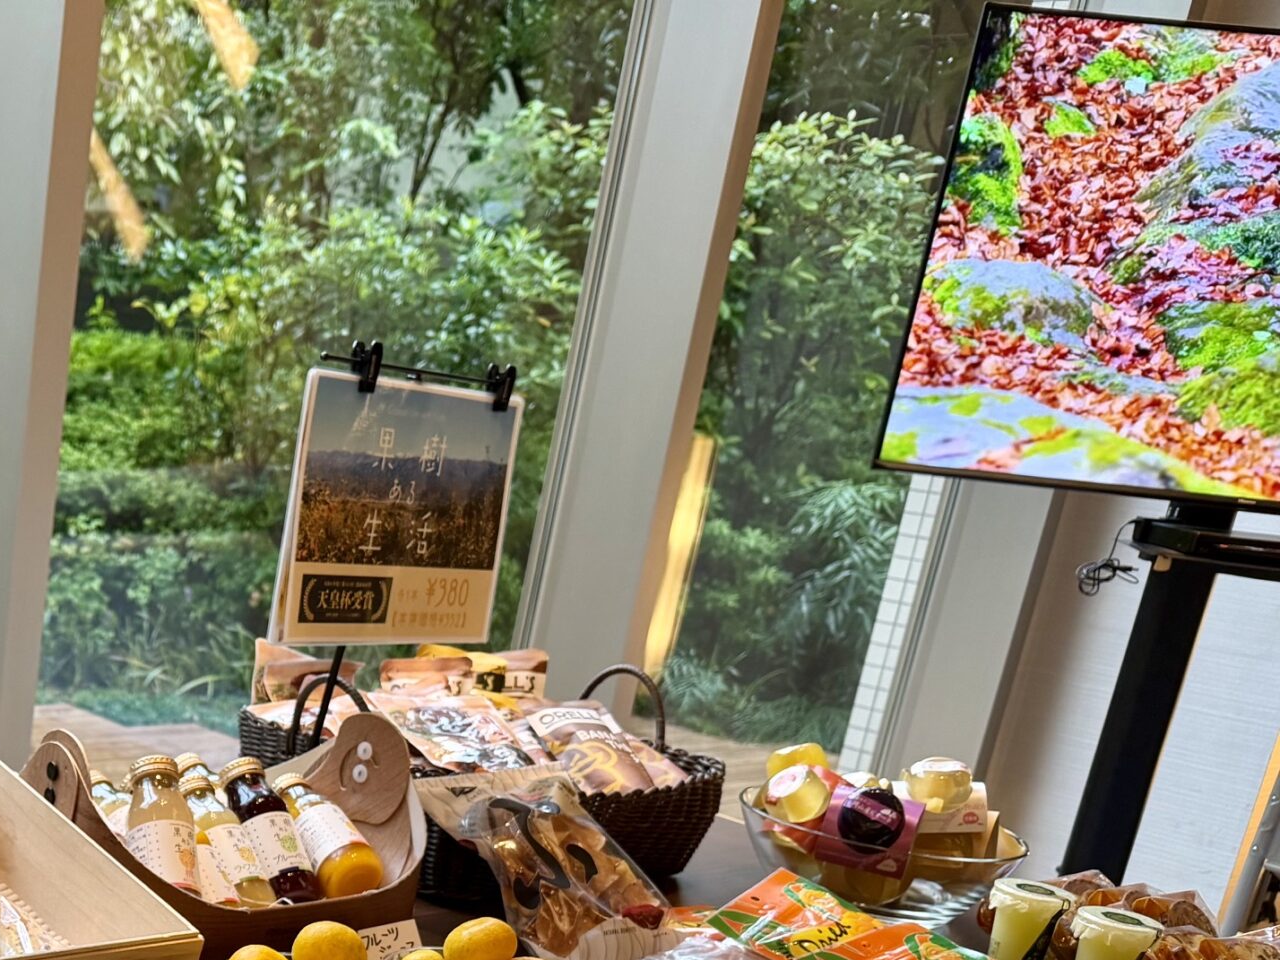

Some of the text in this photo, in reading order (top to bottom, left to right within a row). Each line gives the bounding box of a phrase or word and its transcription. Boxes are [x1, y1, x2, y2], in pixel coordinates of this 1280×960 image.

[388, 479, 416, 505] ある
[360, 926, 399, 951] フルーツ
